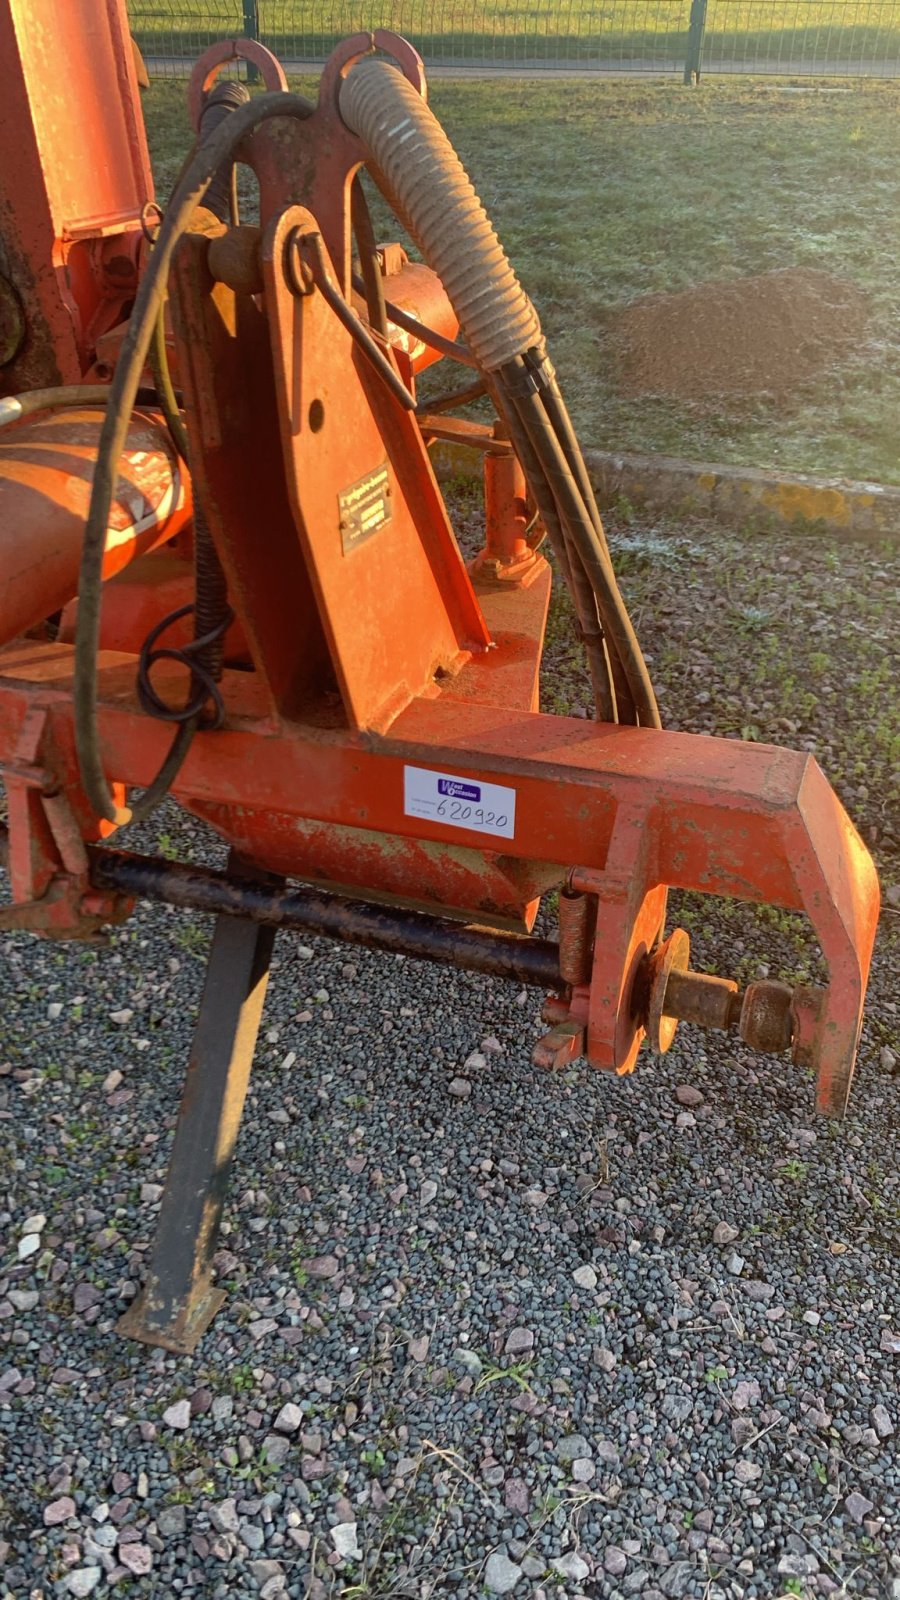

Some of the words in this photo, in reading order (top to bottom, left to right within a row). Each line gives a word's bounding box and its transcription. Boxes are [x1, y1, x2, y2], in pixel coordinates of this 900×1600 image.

[441, 780, 463, 792] West
[447, 788, 477, 797] Occasion
[437, 800, 508, 827] 620920
